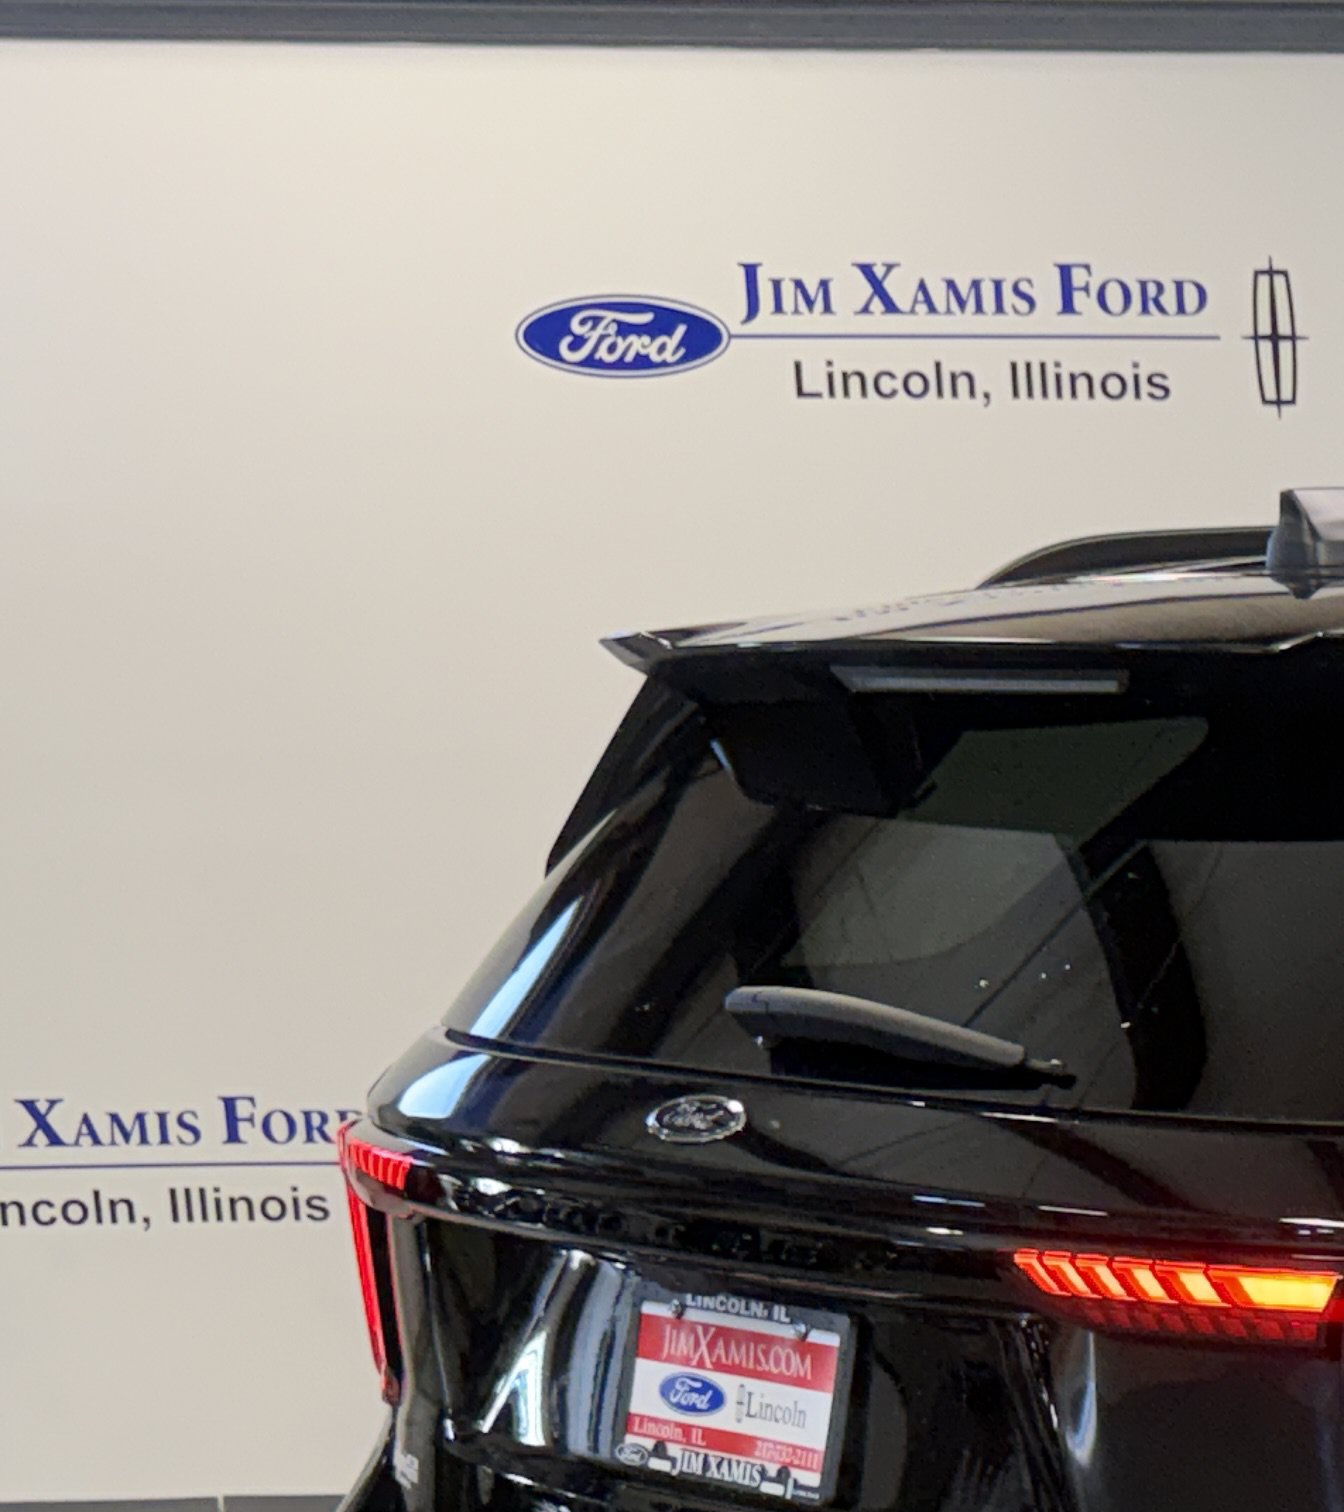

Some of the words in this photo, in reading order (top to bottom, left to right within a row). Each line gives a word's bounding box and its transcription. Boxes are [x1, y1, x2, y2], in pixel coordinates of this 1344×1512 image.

[559, 308, 685, 364] Ford
[794, 360, 990, 407] Lincoln,
[1010, 361, 1171, 401] Illinois
[169, 1186, 330, 1223] Illinois
[773, 1305, 791, 1323] IL
[670, 1377, 714, 1411] Ford
[746, 1391, 808, 1429] Lincoln
[671, 1451, 705, 1477] JIM
[706, 1455, 763, 1488] XAMIS
